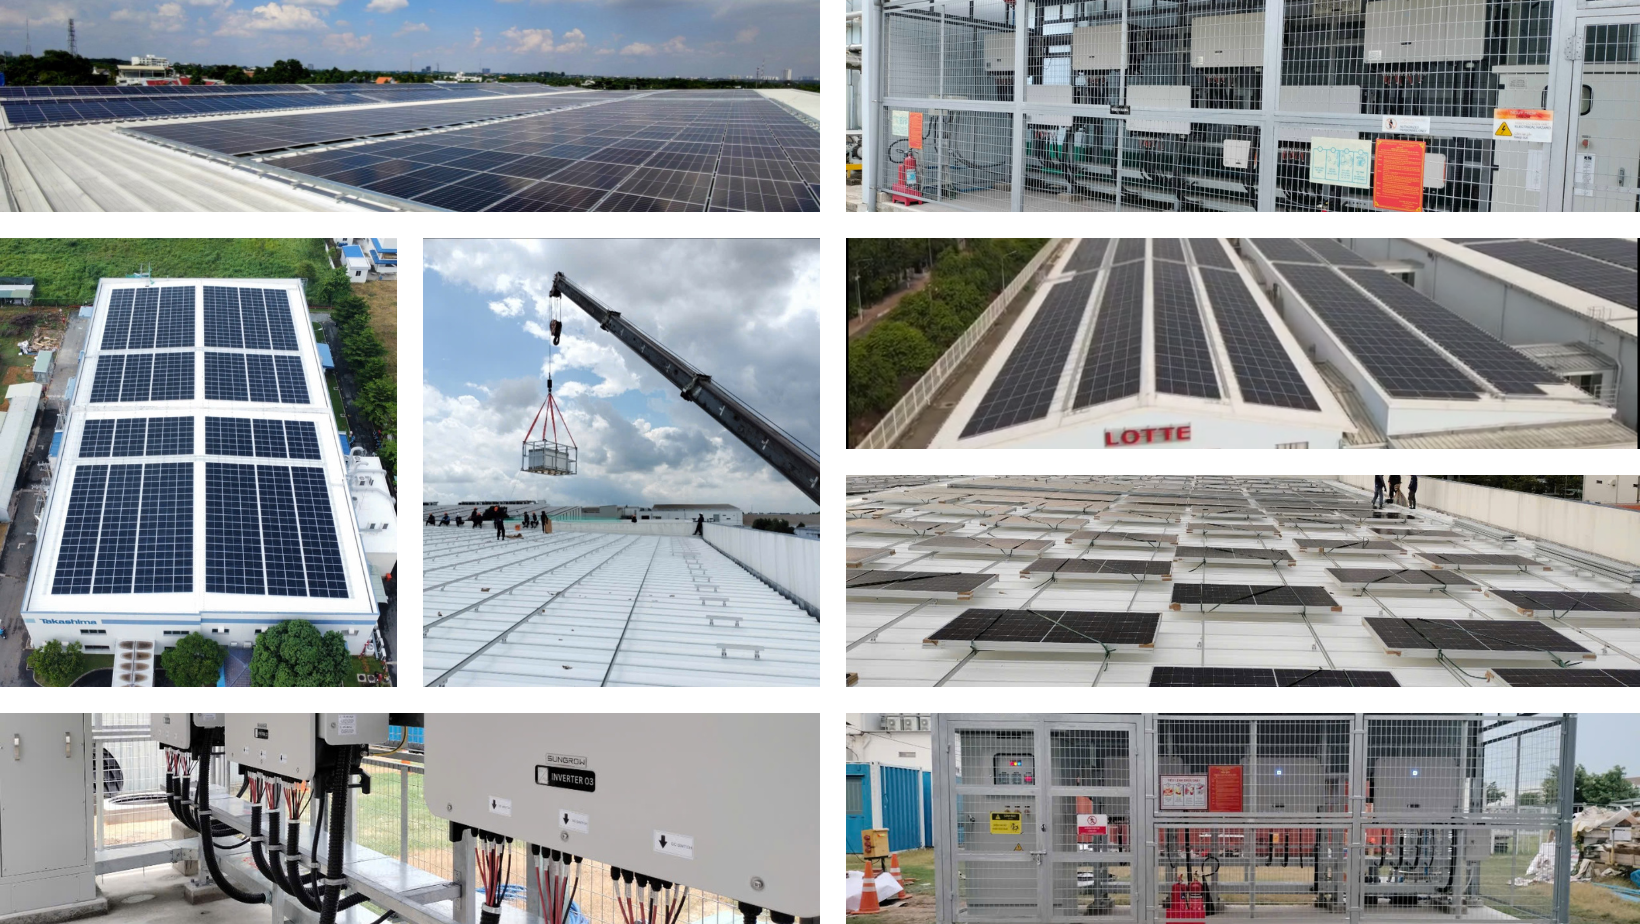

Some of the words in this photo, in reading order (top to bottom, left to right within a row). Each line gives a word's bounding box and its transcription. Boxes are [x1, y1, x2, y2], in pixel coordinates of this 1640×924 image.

[1104, 426, 1191, 447] LOTTE
[547, 755, 586, 765] SUNGROW
[551, 772, 584, 785] INVERTER
